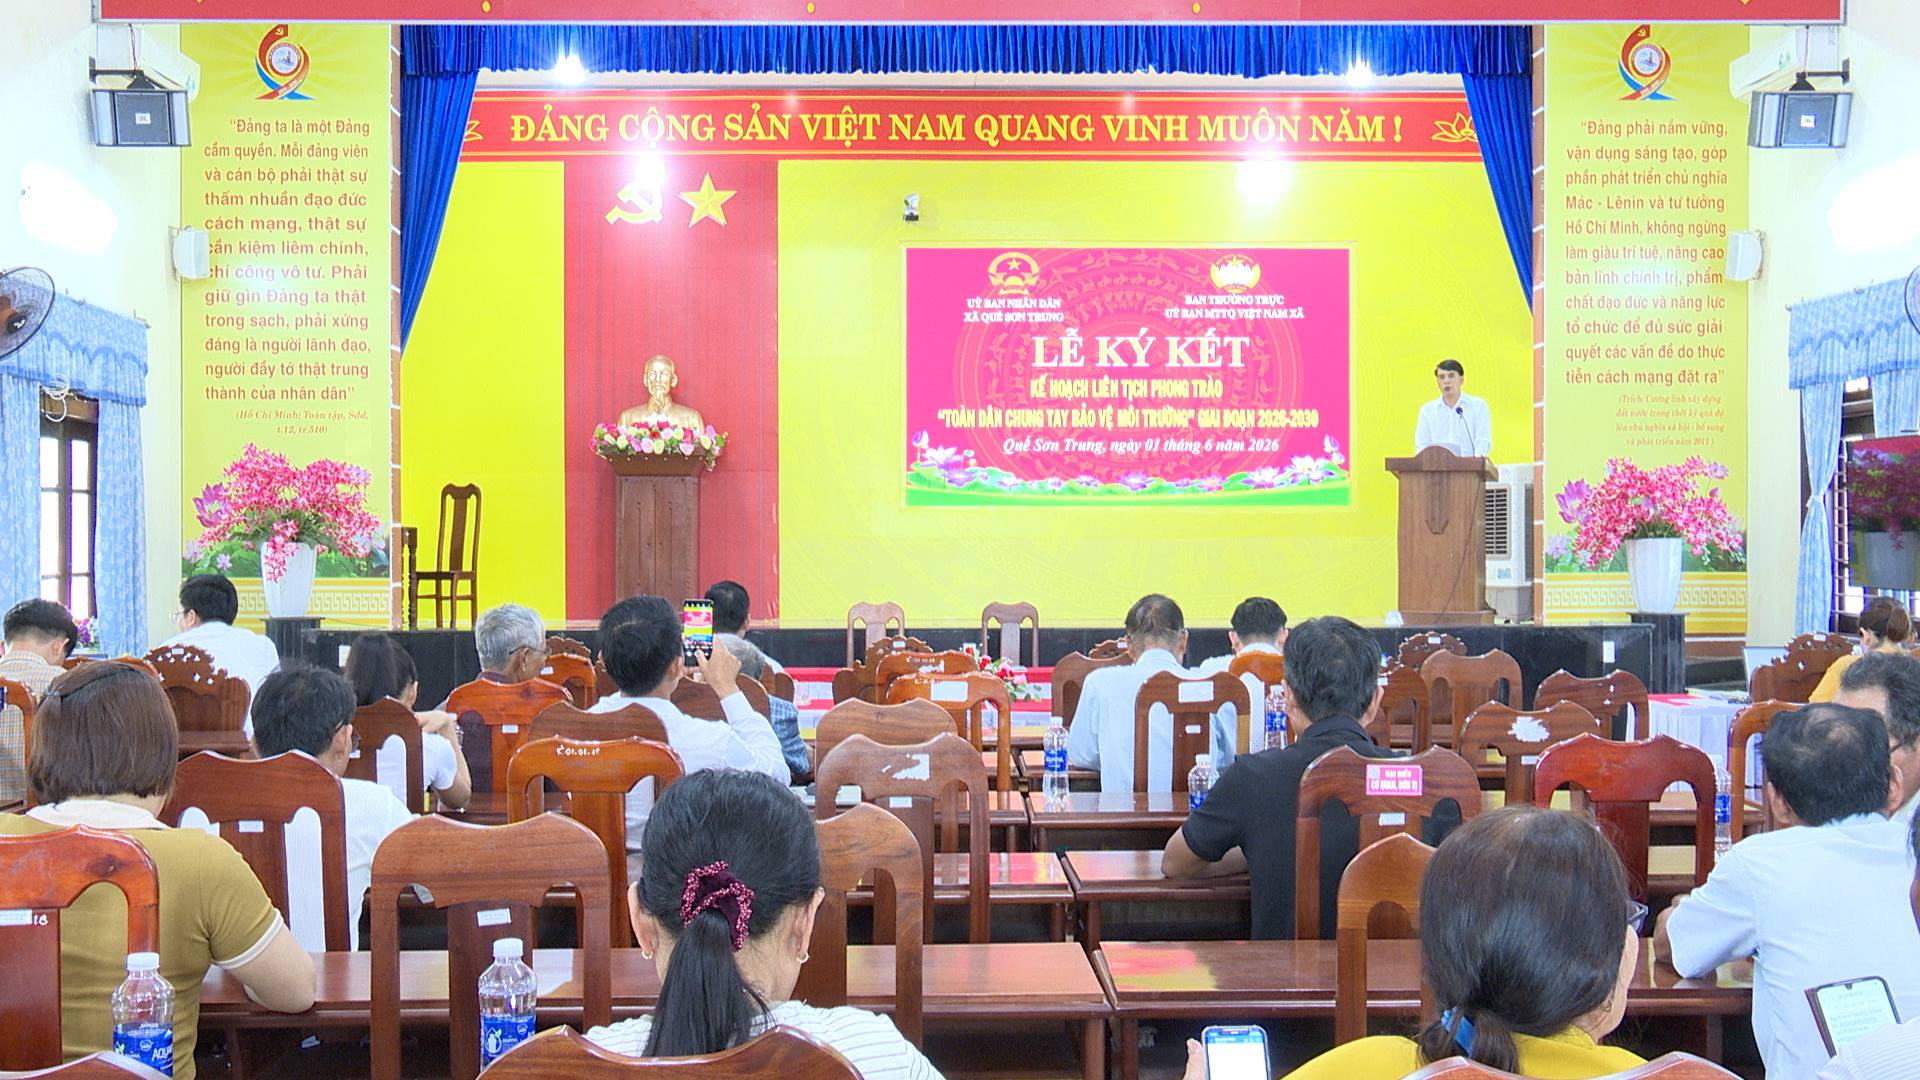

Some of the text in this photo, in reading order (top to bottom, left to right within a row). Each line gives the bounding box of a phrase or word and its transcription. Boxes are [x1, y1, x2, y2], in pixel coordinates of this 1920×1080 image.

[275, 120, 287, 133] ta
[292, 119, 302, 133] là
[307, 120, 331, 136] một
[336, 118, 369, 137] Đảng
[511, 104, 608, 141] ĐẢNG
[618, 108, 716, 148] CỘNG
[724, 102, 791, 141] SẢN
[798, 105, 880, 147] VIỆT
[889, 114, 965, 141] NAM
[974, 114, 1095, 147] QUANG
[1101, 114, 1189, 142] VINH
[1197, 108, 1304, 142] MUÔN
[1309, 108, 1385, 142] NĂM
[1627, 119, 1654, 138] phải
[1659, 118, 1686, 134] nắm
[204, 141, 229, 157] cầm
[281, 141, 302, 157] Mỗi
[307, 142, 338, 161] đảng
[343, 144, 368, 158] viên
[1567, 145, 1590, 163] vận
[1596, 146, 1629, 163] dụng
[1635, 145, 1667, 163] sáng
[1702, 145, 1727, 163] góp
[205, 166, 368, 185] và cán bộ phải thật sự
[1566, 167, 1727, 188] phần phát triển chủ nghĩa
[205, 190, 366, 209] thấm nhuần đạo đức
[1566, 195, 1592, 210] Mác
[1607, 195, 1644, 209] Lênin
[1649, 195, 1664, 209] và
[1669, 196, 1682, 209] tư
[1686, 193, 1724, 213] tưởng
[205, 216, 244, 230] cách
[308, 217, 340, 233] thật
[346, 217, 367, 233] sự
[1566, 219, 1582, 234] Hồ
[1586, 220, 1606, 234] Chí
[1647, 220, 1683, 238] không
[1689, 220, 1726, 238] ngừng
[239, 240, 275, 257] kiệm
[282, 240, 313, 255] liêm
[205, 314, 244, 330] trong
[295, 312, 326, 331] phải
[332, 313, 368, 331] xứng
[205, 337, 240, 354] đáng
[246, 337, 257, 351] là
[262, 337, 301, 355] người
[307, 338, 336, 352] lãnh
[1032, 327, 1250, 368] LỄ KÝ KẾT
[1566, 367, 1591, 384] tiễn
[1597, 369, 1629, 384] cách
[1635, 372, 1672, 387] mạng
[1678, 369, 1699, 386] đặt
[206, 385, 245, 400] thành
[251, 384, 275, 400] của
[281, 386, 315, 400] nhân
[1031, 373, 1222, 401] KẾ HOẠCH LIÊN TỊCH PHONG TRÀO
[979, 405, 1002, 427] DÂN
[1006, 410, 1044, 427] CHUNG
[1046, 409, 1068, 427] TAY
[1072, 403, 1096, 427] BẢO
[1099, 405, 1113, 430] VỆ
[1118, 405, 1139, 427] MÔI
[1198, 409, 1220, 427] GIAI
[1223, 410, 1255, 430] ĐOẠN
[1258, 409, 1318, 427] 2026-2030
[1004, 436, 1278, 454] Quế Sơn Trung, ngày 01 tháng 6 năm 2026
